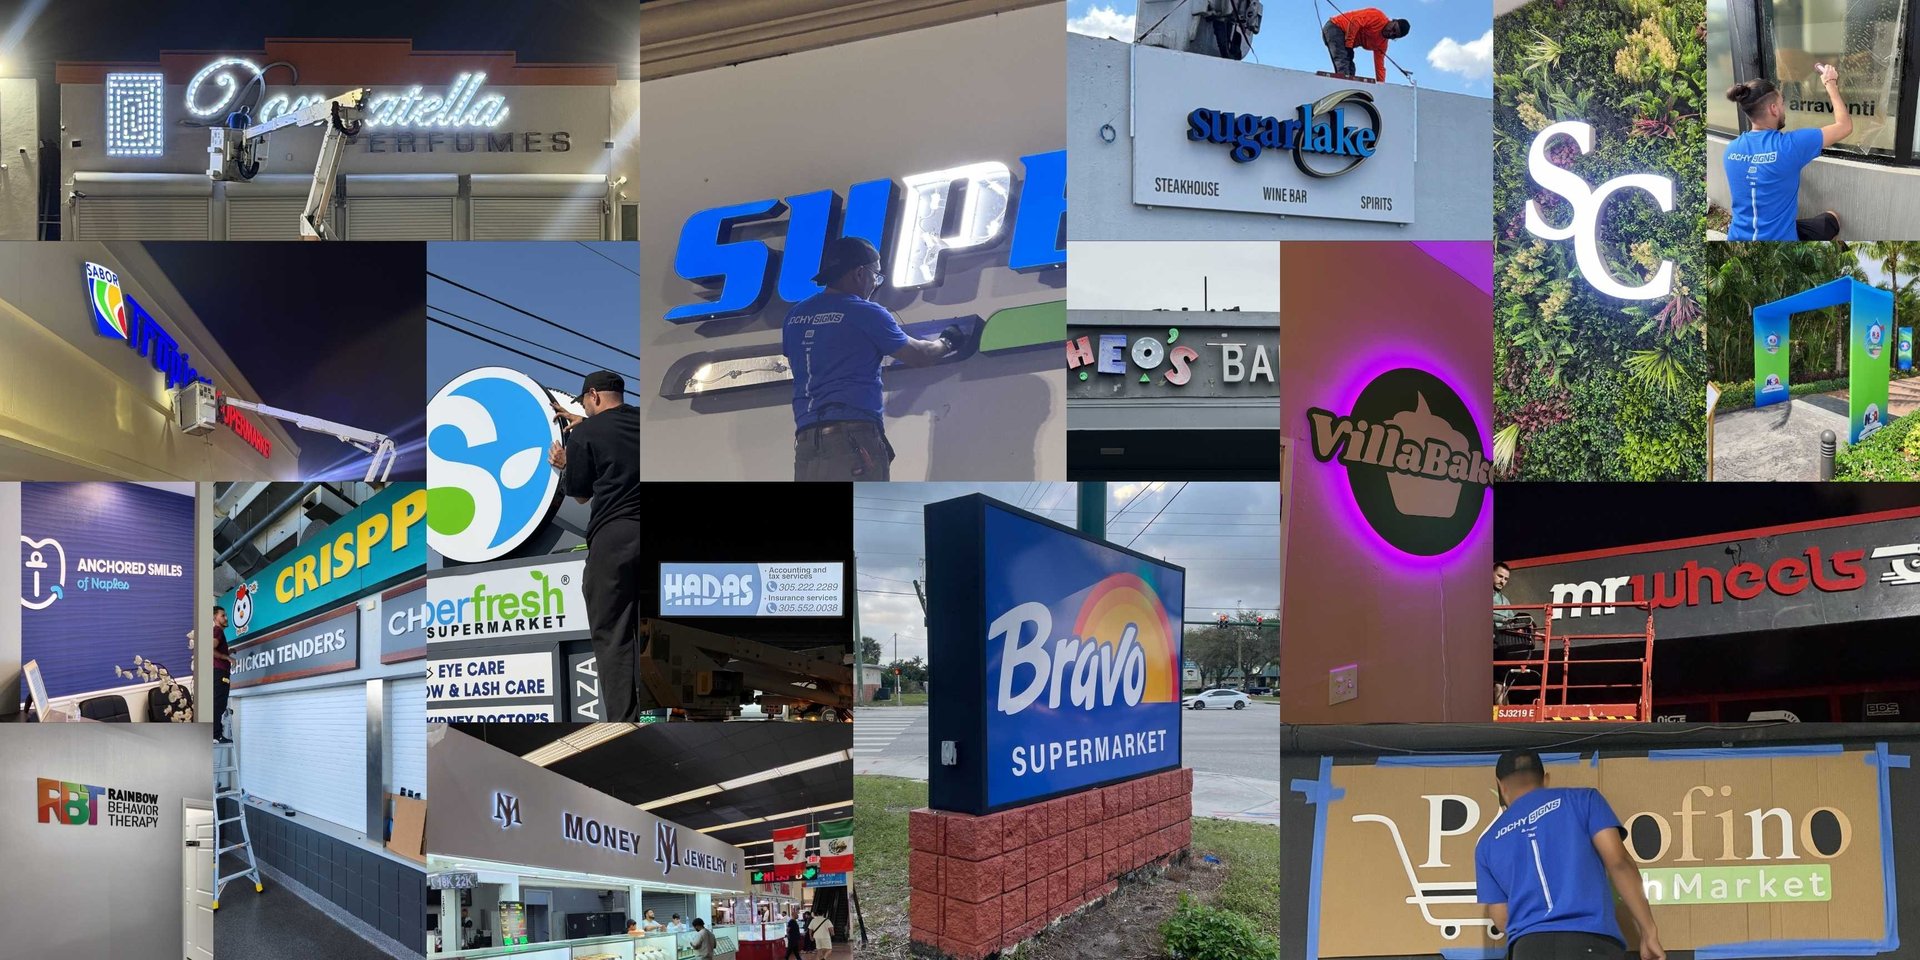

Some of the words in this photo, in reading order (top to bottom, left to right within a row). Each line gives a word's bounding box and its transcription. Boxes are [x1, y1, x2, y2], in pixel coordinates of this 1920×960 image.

[1789, 100, 1875, 116] arravnti
[360, 132, 571, 153] ERFUMES
[1728, 154, 1751, 162] JOCHY
[1752, 152, 1777, 163] SIGNS
[1155, 177, 1219, 197] STEAKHOUSE
[1263, 187, 1287, 202] WINE
[1289, 189, 1307, 203] BAR
[1360, 196, 1393, 211] SPIRITS
[86, 264, 119, 286] SABOR
[813, 313, 843, 324] SIGNS
[1222, 344, 1280, 383] BA
[219, 403, 272, 459] UPERMARKET
[275, 489, 427, 604] CRISPP
[77, 558, 146, 574] ANCHORED
[148, 563, 182, 577] SMILES
[769, 567, 810, 575] Accounting
[77, 577, 89, 591] of
[91, 578, 129, 591] Naples
[664, 574, 752, 606] HADAS
[778, 583, 838, 591] 305.222.2289
[778, 604, 838, 612] 305.552.0038
[427, 615, 566, 639] SUPERMARKET
[277, 628, 346, 664] TENDERS
[988, 601, 1145, 715] Bravo
[438, 663, 462, 678] EYE
[467, 660, 505, 676] CARE
[427, 685, 444, 698] W
[449, 684, 459, 697] &
[465, 682, 500, 697] LASH
[505, 679, 545, 694] CARE
[1498, 709, 1528, 718] SJ3219
[1012, 729, 1167, 777] SUPERMARKET
[37, 778, 105, 825] RBT
[108, 788, 158, 804] RAINBOW
[108, 801, 159, 816] BEHAVIOR
[108, 814, 159, 828] THERAPY
[1495, 817, 1528, 840] JOCHY
[1529, 798, 1561, 824] SIGNS
[564, 812, 641, 855] MONEY
[684, 849, 727, 873] JEWELRY
